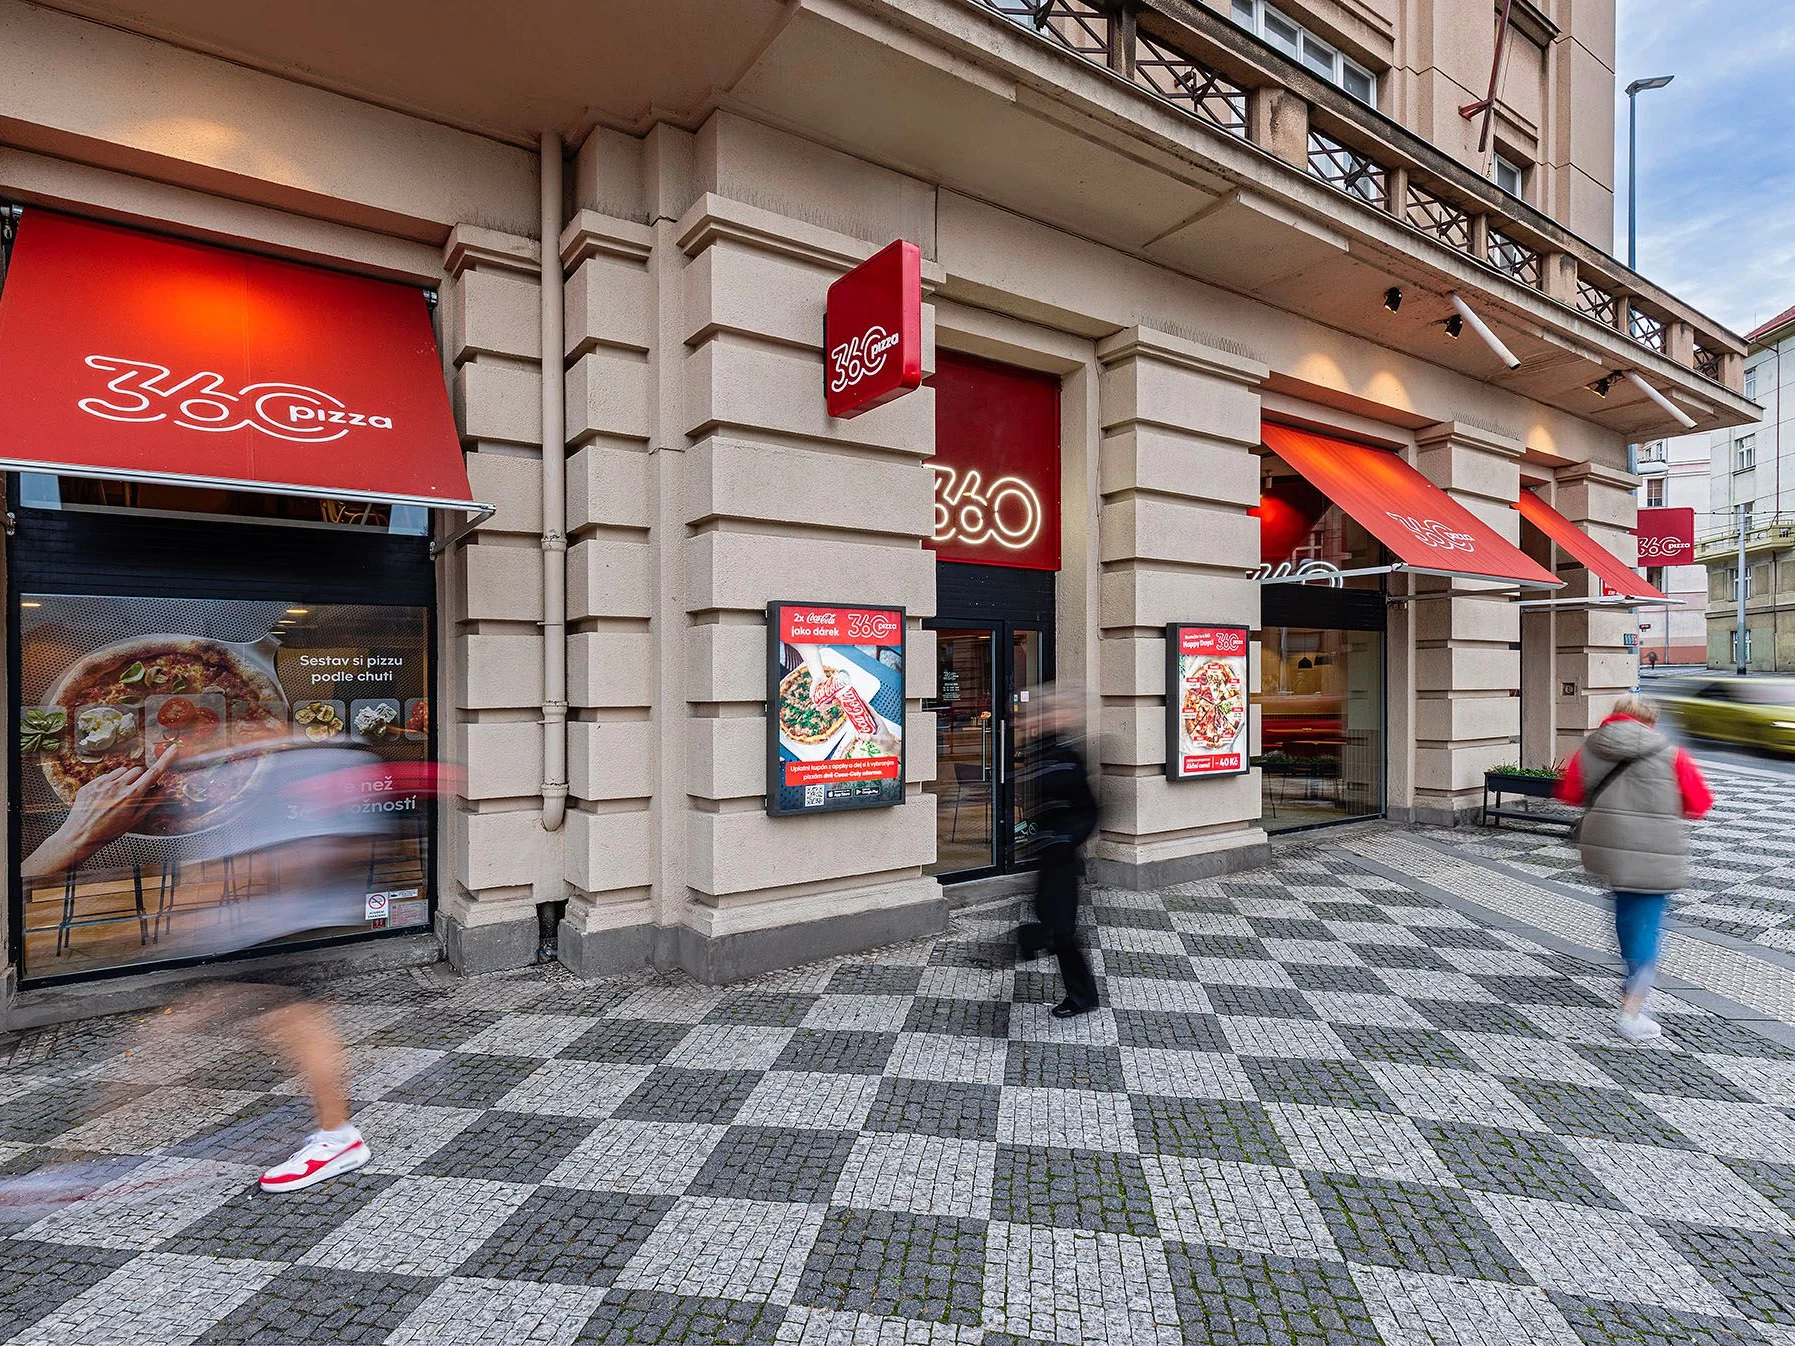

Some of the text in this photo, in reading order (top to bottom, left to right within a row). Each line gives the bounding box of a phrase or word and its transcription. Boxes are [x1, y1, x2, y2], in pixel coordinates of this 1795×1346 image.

[831, 326, 899, 393] 360 pizza
[78, 354, 394, 443] 360 pizza
[1668, 542, 1691, 550] pizza
[793, 612, 805, 623] 2x
[791, 625, 840, 638] jako dárek
[847, 613, 897, 639] 360 pizza
[299, 654, 404, 669] Sestav si pizzu
[310, 670, 393, 685] podle chuti
[360, 775, 394, 793] než
[350, 794, 417, 815] ožností
